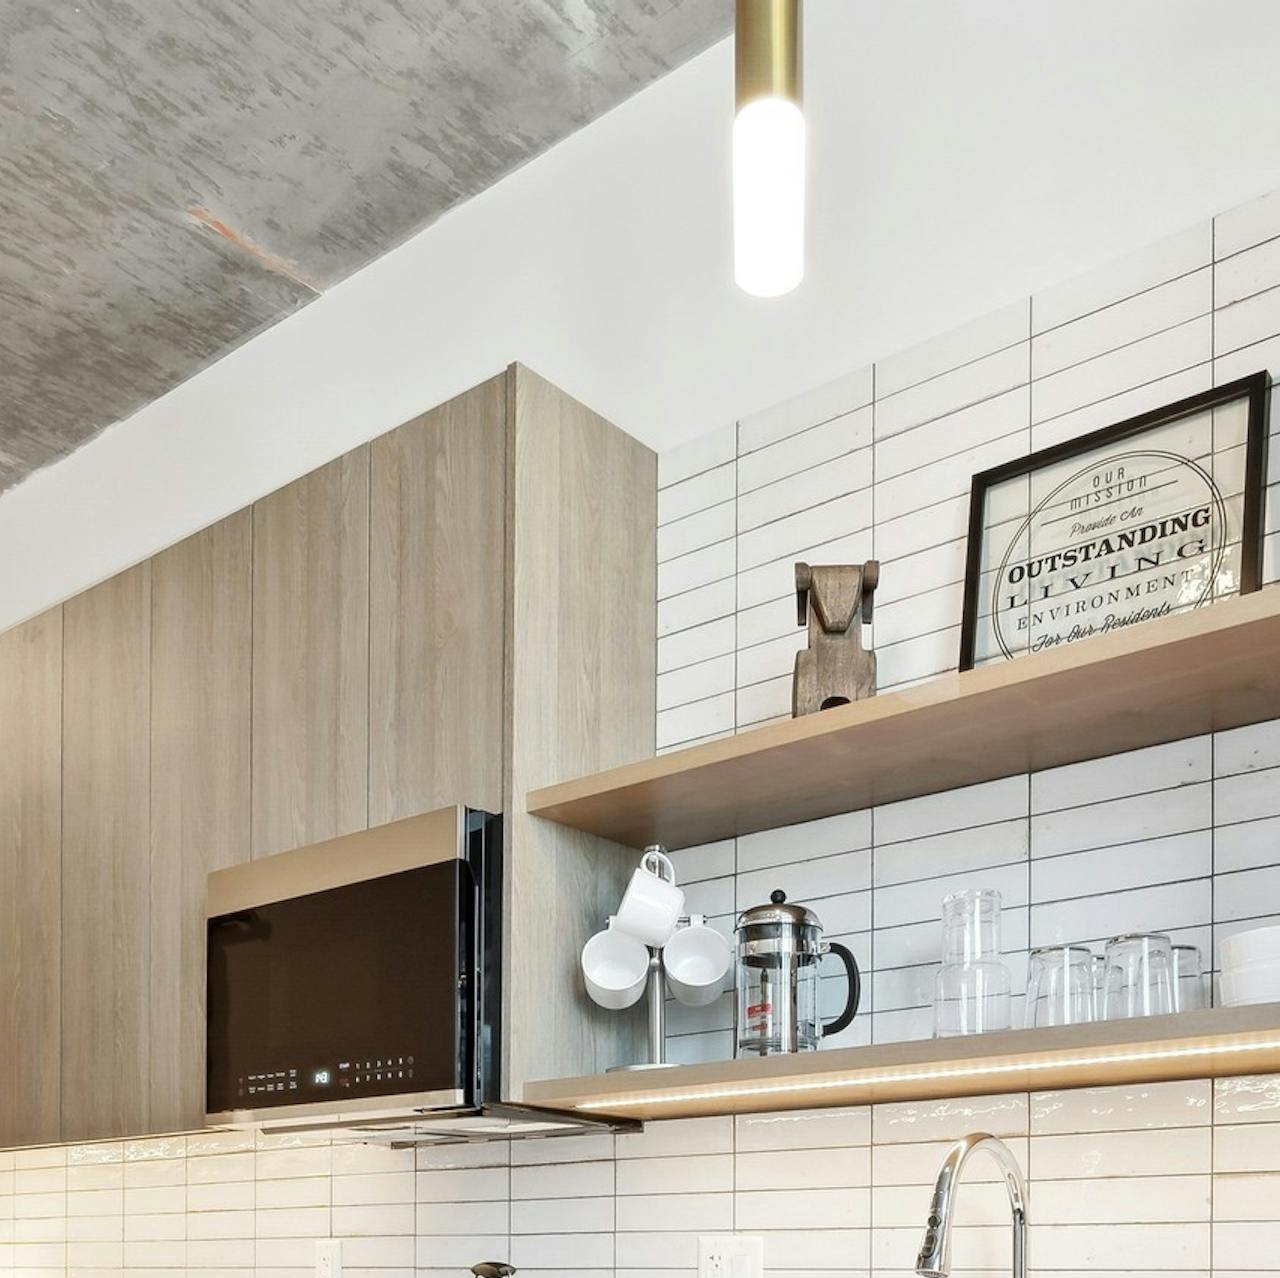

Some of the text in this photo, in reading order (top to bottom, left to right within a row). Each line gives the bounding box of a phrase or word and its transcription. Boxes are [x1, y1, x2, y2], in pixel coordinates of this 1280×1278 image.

[1092, 467, 1125, 489] OUR
[1008, 507, 1211, 584] OUTSTANDING
[1069, 505, 1144, 538] Provide An
[1006, 539, 1208, 609] LIVING
[1016, 568, 1195, 631] ENVIRONMENT
[1032, 601, 1172, 652] For Our Residents
